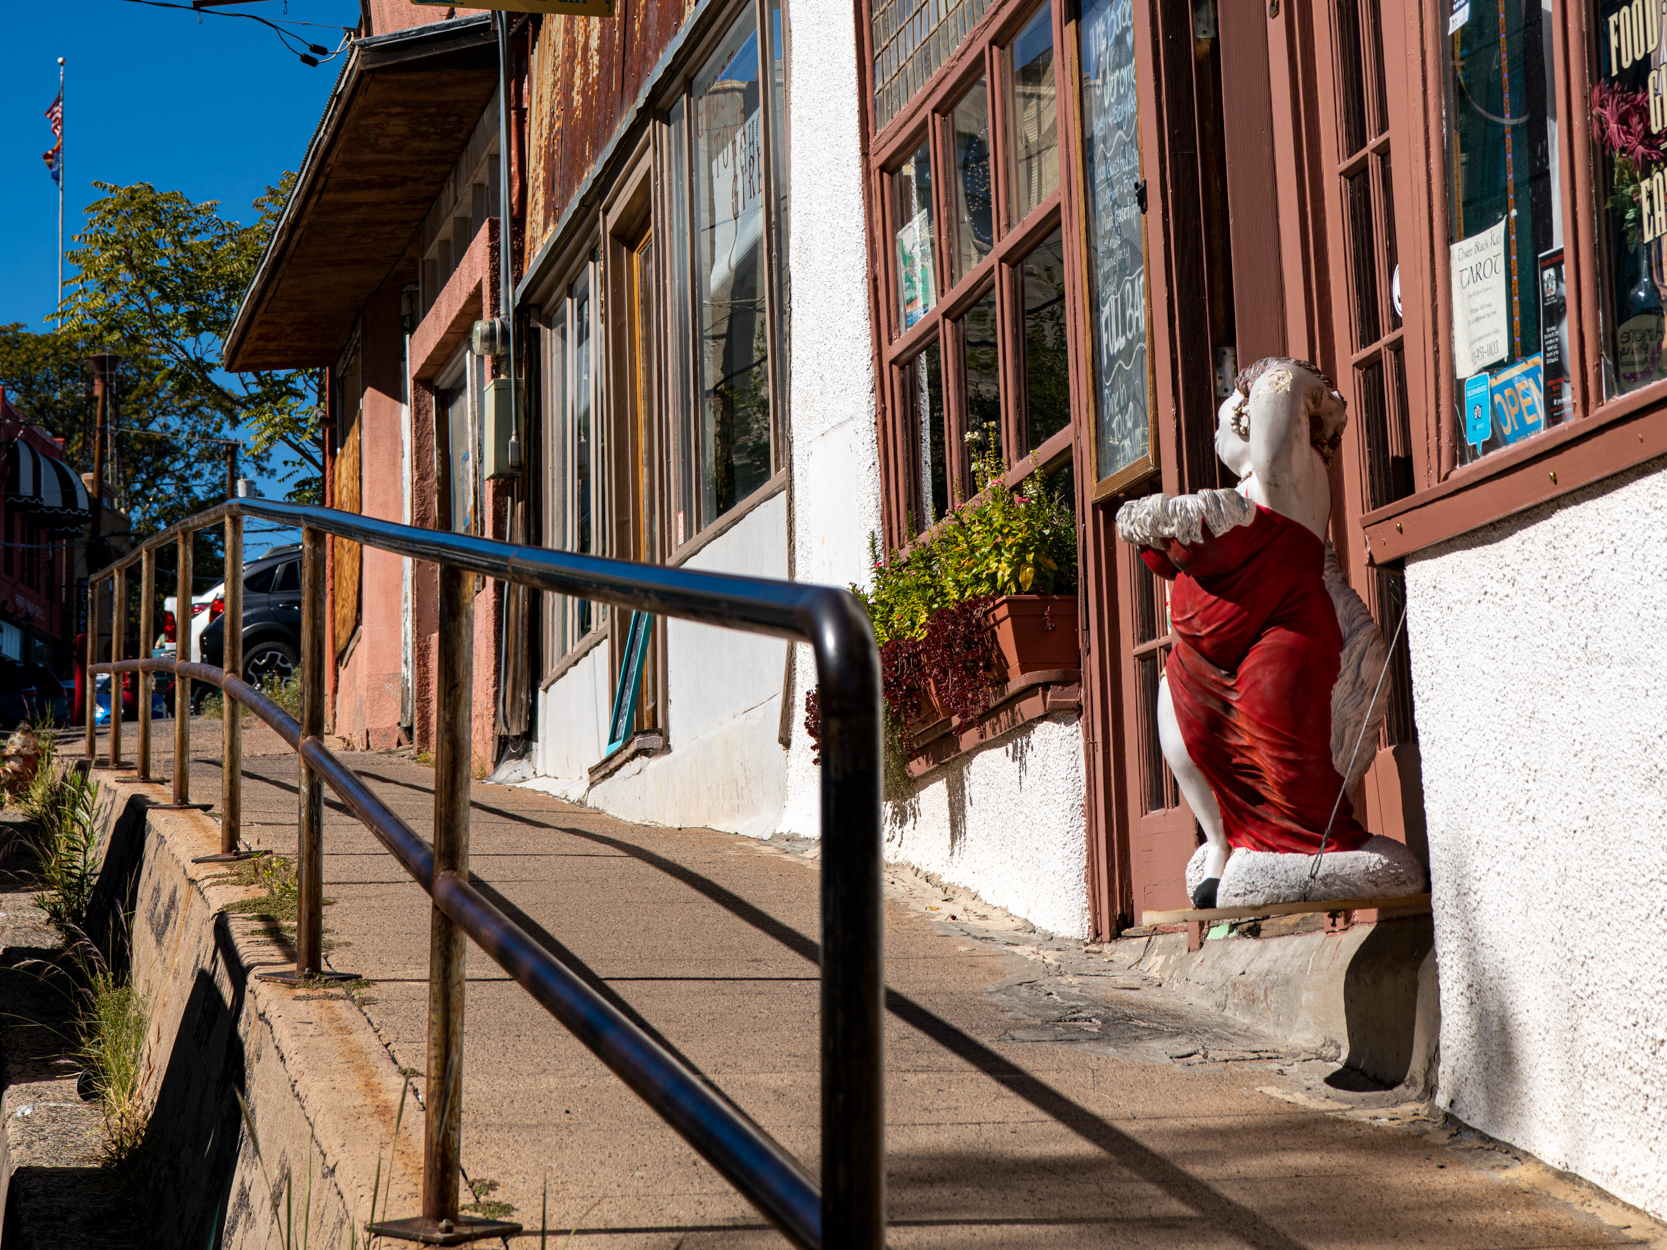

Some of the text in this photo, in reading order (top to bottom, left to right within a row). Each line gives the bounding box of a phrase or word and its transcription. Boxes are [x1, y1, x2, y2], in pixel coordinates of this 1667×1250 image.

[696, 50, 734, 139] GHOST
[1458, 253, 1502, 290] TAROT
[1493, 372, 1544, 435] OPEN
